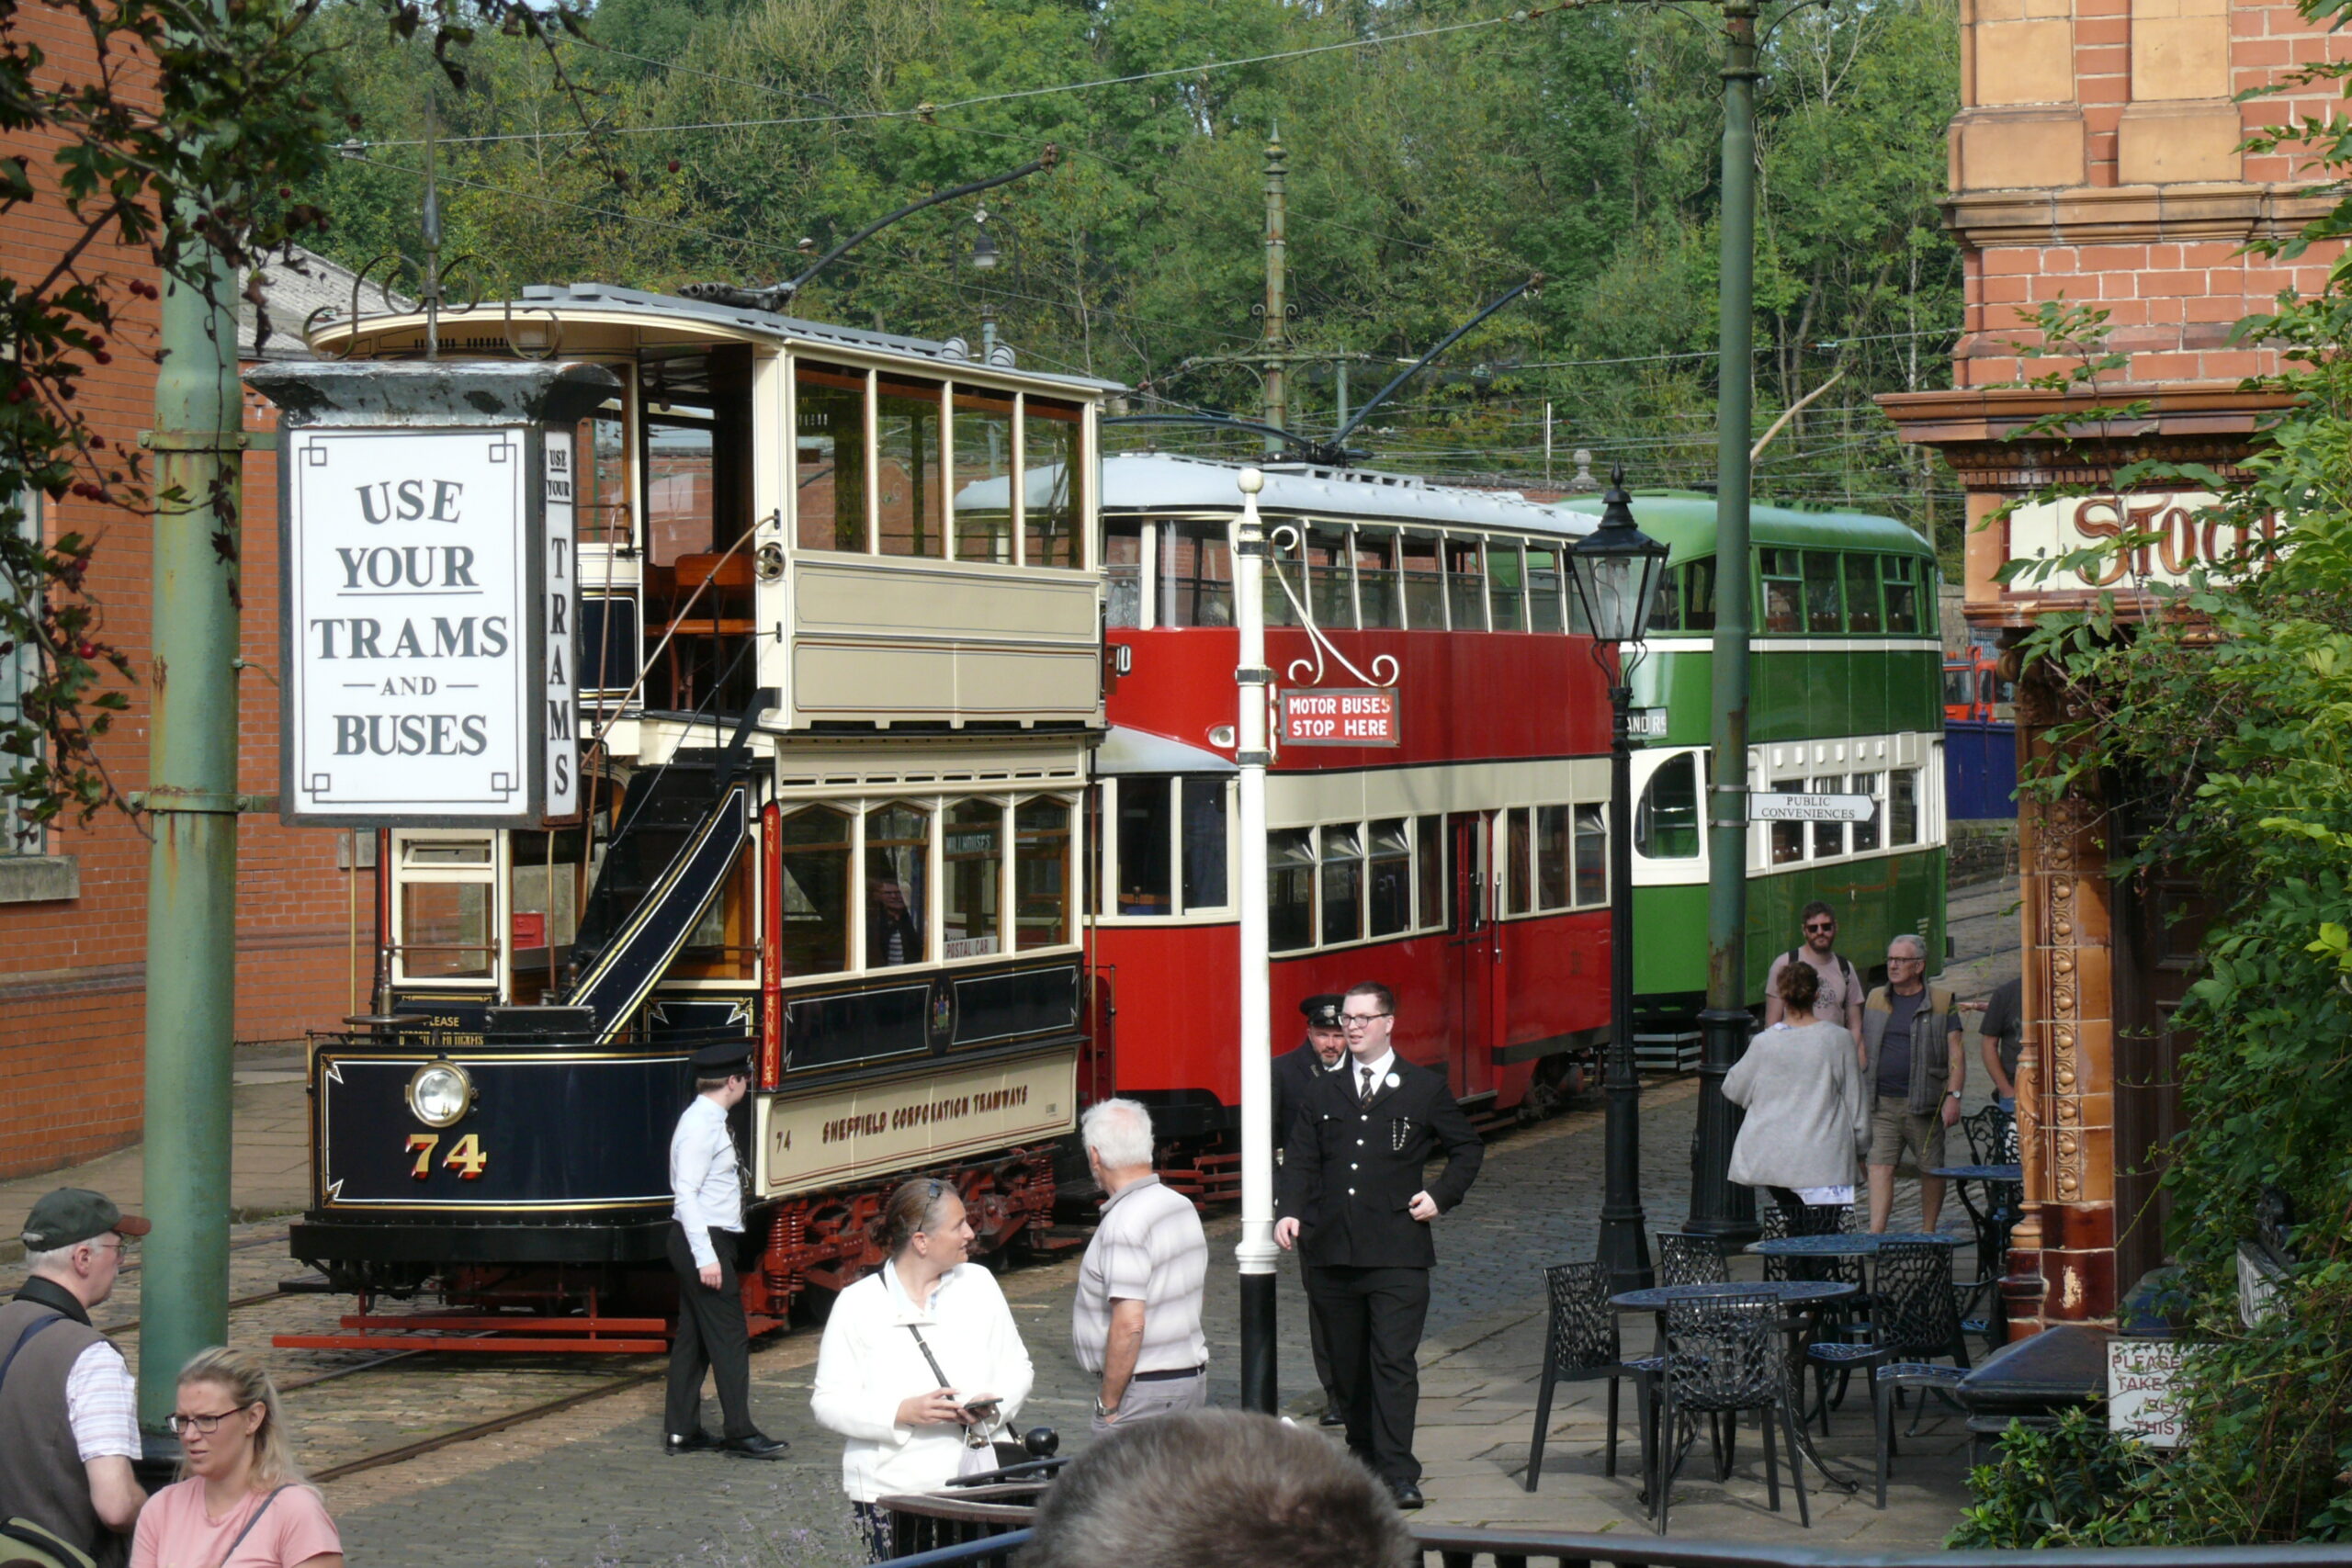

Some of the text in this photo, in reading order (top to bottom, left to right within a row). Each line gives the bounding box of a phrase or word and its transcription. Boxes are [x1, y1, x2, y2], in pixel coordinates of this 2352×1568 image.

[548, 448, 567, 467] USE
[547, 479, 571, 497] YOUR
[356, 479, 464, 525] USE
[335, 545, 479, 588] YOUR
[311, 615, 508, 660] TRAMS
[548, 537, 571, 795] TRAMS
[380, 676, 437, 695] AND
[1289, 696, 1391, 715] MOTOR BUSES
[333, 713, 488, 757] BUSES
[1293, 719, 1388, 737] STOP HERE
[1786, 796, 1831, 807] PUBLIC
[1761, 807, 1855, 819] CONVENIENCES
[946, 938, 989, 958] POSTAL CAR
[423, 1016, 460, 1027] LEASE
[822, 1111, 888, 1145] SHEFFIELD
[892, 1095, 970, 1132] CORPORATION
[973, 1084, 1028, 1115] TRAMWAYS
[775, 1129, 792, 1154] 74
[405, 1134, 488, 1179] 74
[2112, 1355, 2183, 1370] PLEASE
[2117, 1376, 2163, 1391] TAKE
[2133, 1420, 2175, 1435] THIS
